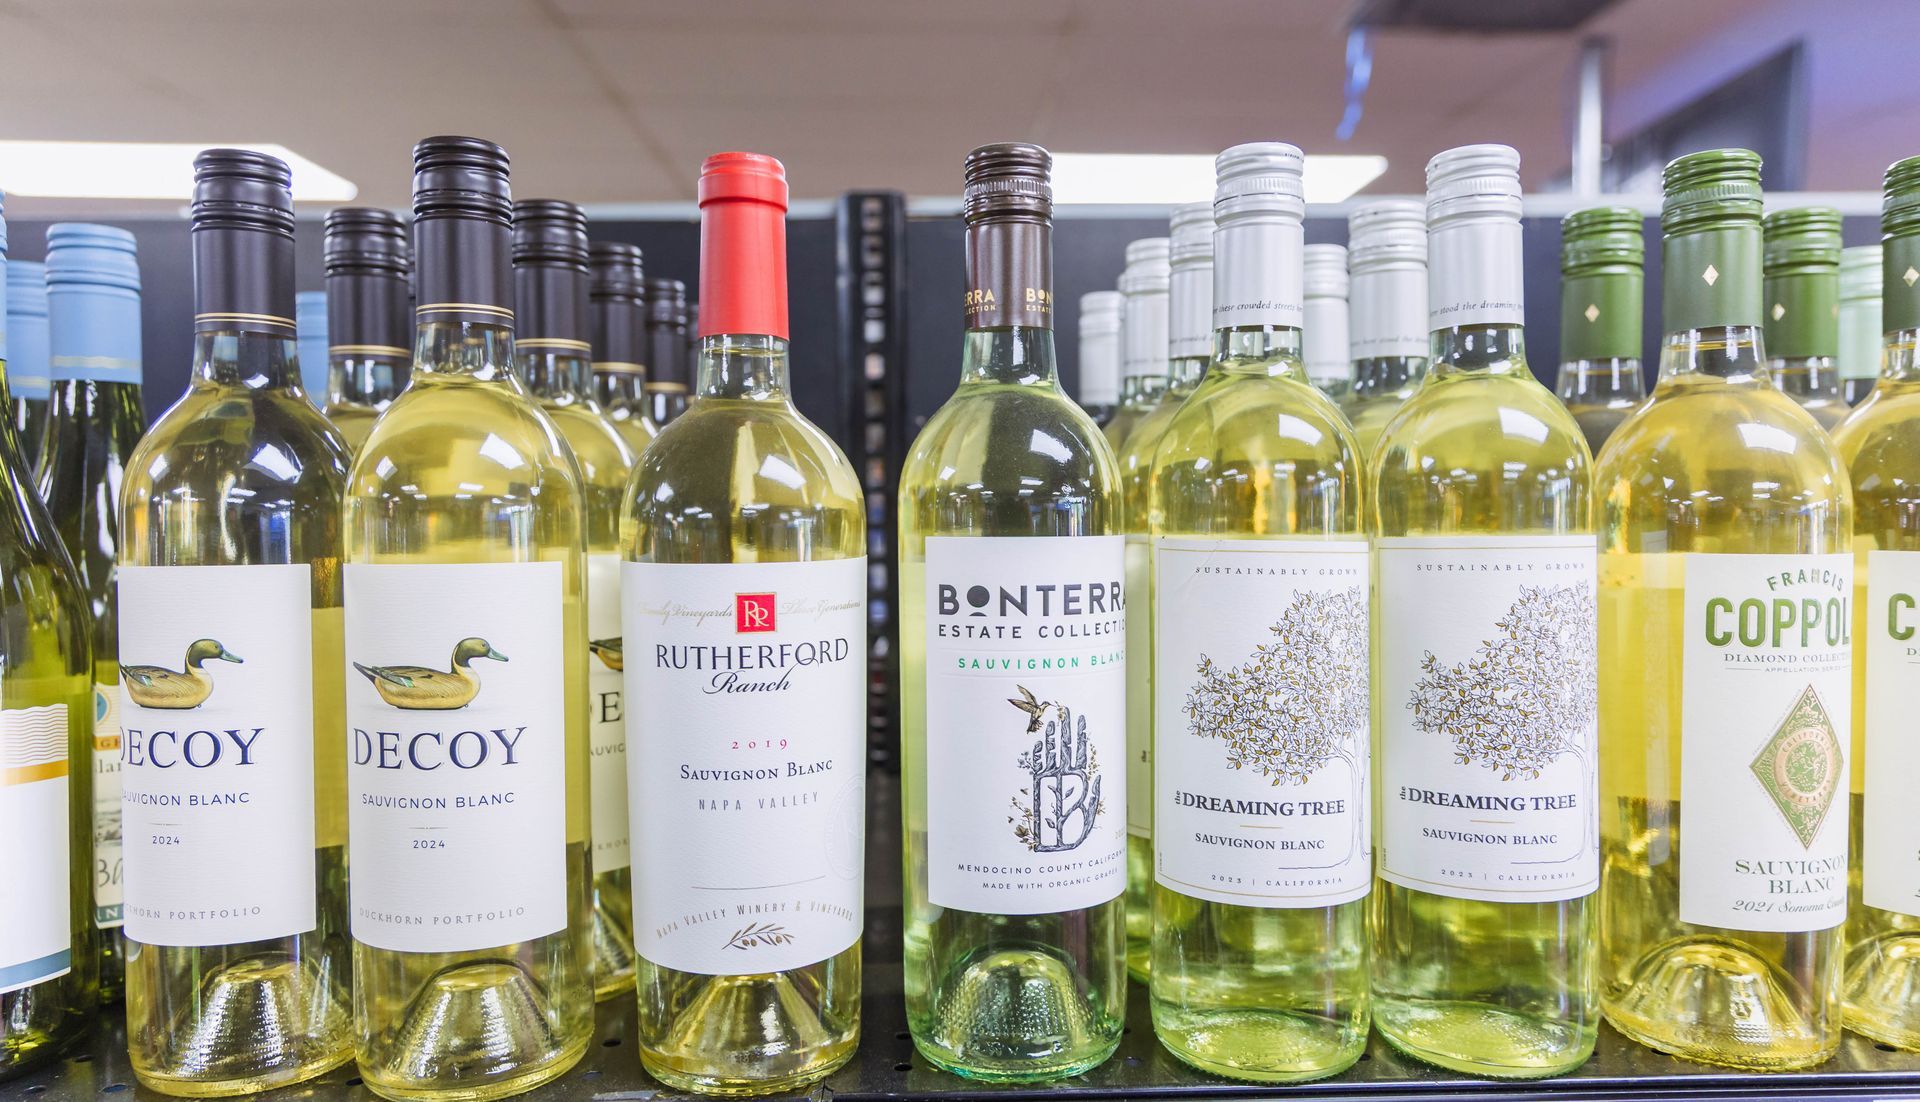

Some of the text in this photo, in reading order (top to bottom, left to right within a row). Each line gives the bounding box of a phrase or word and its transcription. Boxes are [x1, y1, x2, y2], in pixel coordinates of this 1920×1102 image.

[1236, 300, 1272, 310] crowded
[1440, 303, 1459, 315] stood
[1462, 301, 1477, 310] the
[1195, 566, 1308, 576] SUSTAINABLY
[1416, 563, 1535, 572] SUSTAINABLY
[1767, 568, 1844, 592] FRANCIS
[938, 624, 1023, 639] ESTATE
[655, 638, 849, 670] RUTHERFORD
[1723, 653, 1798, 664] DIAMOND
[958, 656, 1080, 670] SAUVIGNON
[702, 659, 792, 695] Ranch
[352, 726, 528, 771] DECOY
[731, 737, 789, 751] 2019
[189, 792, 250, 806] BLANC
[361, 791, 516, 809] SAUVIGNON BLANC
[699, 791, 819, 811] NAPA VALLEY
[1181, 791, 1346, 817] DREAMING TREE
[1408, 787, 1578, 812] DREAMING TREE
[152, 835, 180, 845] 2024
[1194, 831, 1326, 851] SAUVIGNON BLANC
[1422, 826, 1559, 846] SAUVIGNON BLANC
[412, 839, 447, 850] 2024
[957, 863, 1033, 876] MENDOCINO
[1038, 862, 1083, 874] COUNTY
[1735, 855, 1847, 876] SAUVIGNON
[1211, 874, 1344, 888] 2023 CALIFORNIA
[1441, 868, 1577, 882] 2023 CALIFORNIA
[982, 882, 1012, 890] MADE
[1048, 876, 1092, 889] ORGANIC
[1768, 877, 1834, 894] BLANC
[169, 906, 261, 920] PORTFOLIO
[1732, 899, 1775, 912] 2021
[1777, 902, 1824, 913] Sonoma
[359, 906, 526, 925] DUCKHORN PORTFOLIO
